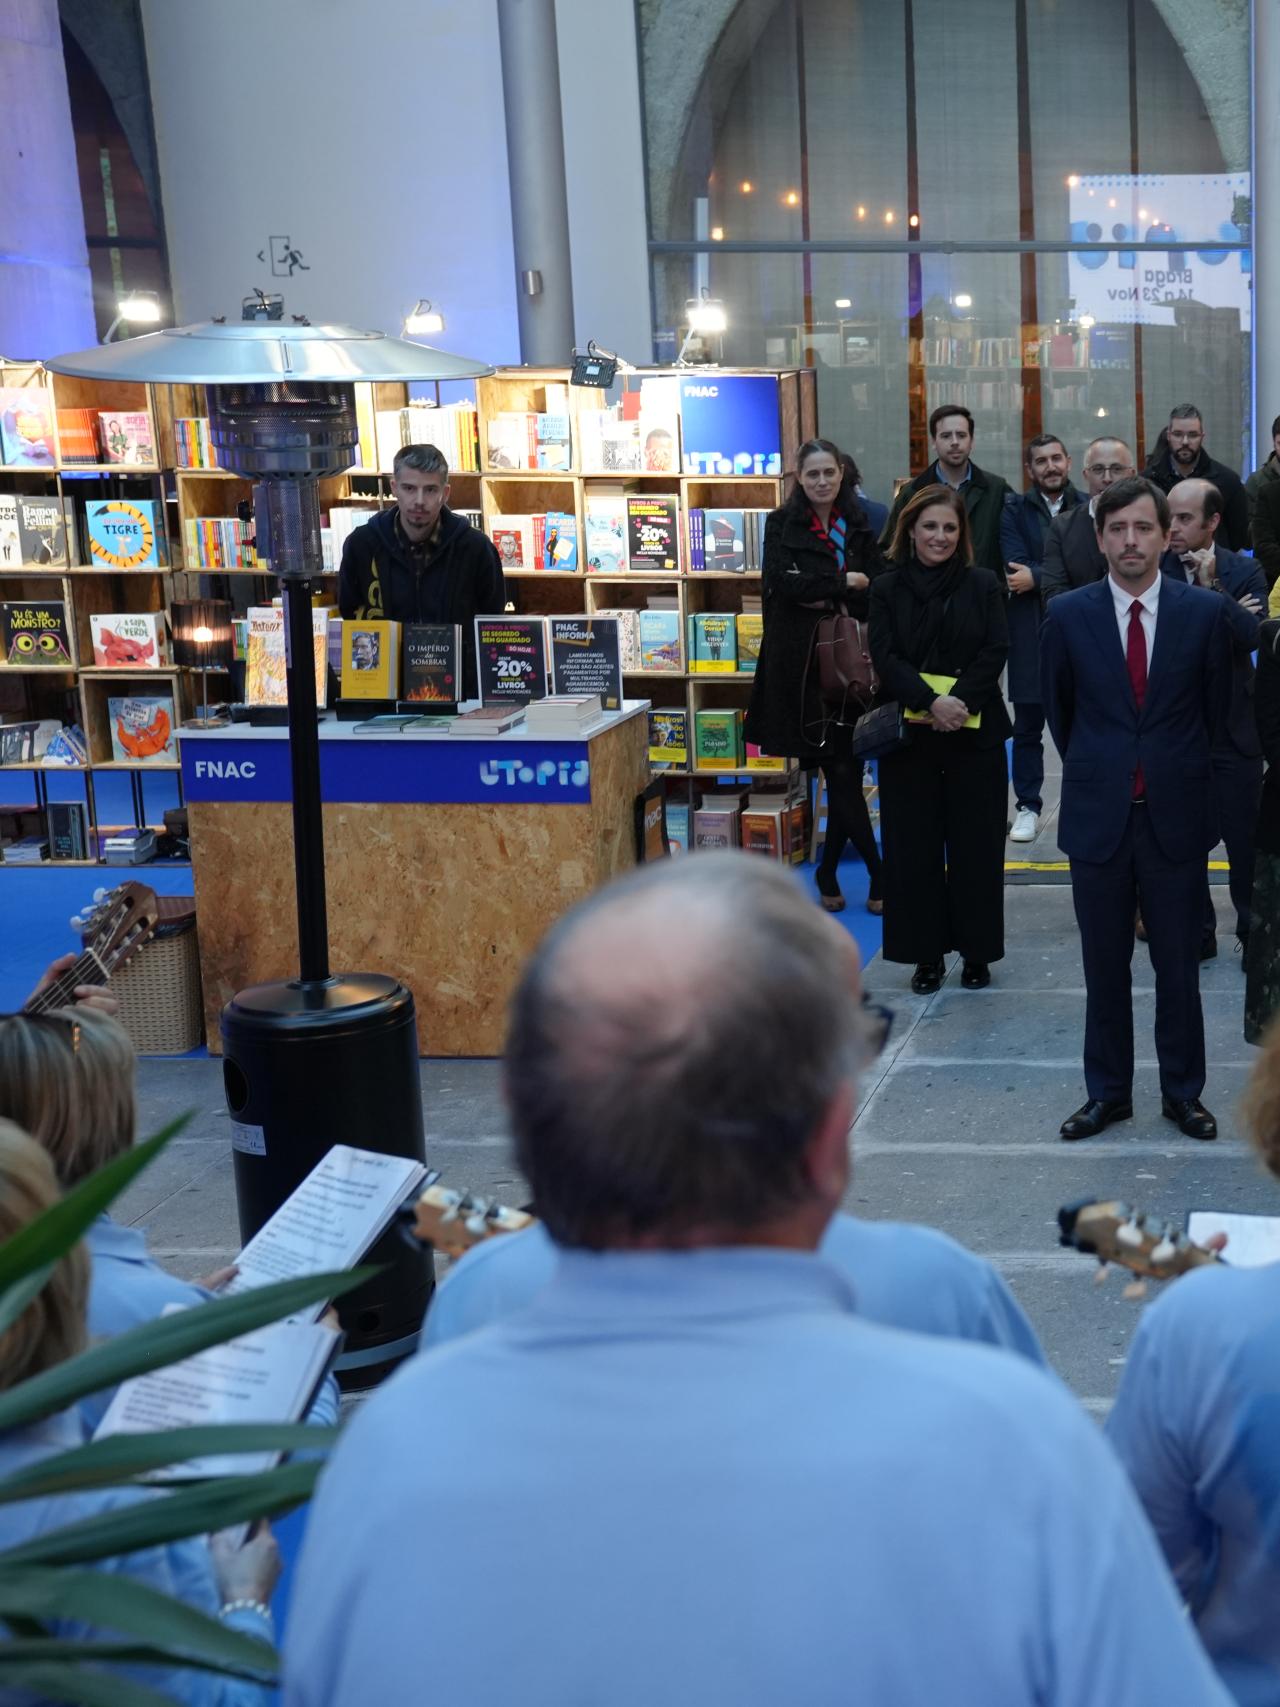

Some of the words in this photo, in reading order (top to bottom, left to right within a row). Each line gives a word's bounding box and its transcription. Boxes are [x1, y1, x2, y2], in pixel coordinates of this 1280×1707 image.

[684, 386, 719, 397] FNAC
[22, 506, 58, 517] Ramon
[104, 525, 139, 535] TIGRE
[637, 527, 669, 542] -20%
[12, 610, 23, 618] TU
[25, 609, 33, 618] ÉS
[11, 618, 61, 629] MONSTRO?
[130, 619, 147, 628] SOPA
[555, 623, 578, 631] FNAC
[124, 627, 149, 637] VERDE
[556, 631, 595, 640] INFORMA
[417, 643, 450, 652] IMPÉRIO
[411, 658, 447, 666] SOMBRAS
[491, 660, 532, 677] -20%
[195, 761, 256, 778] FNAC
